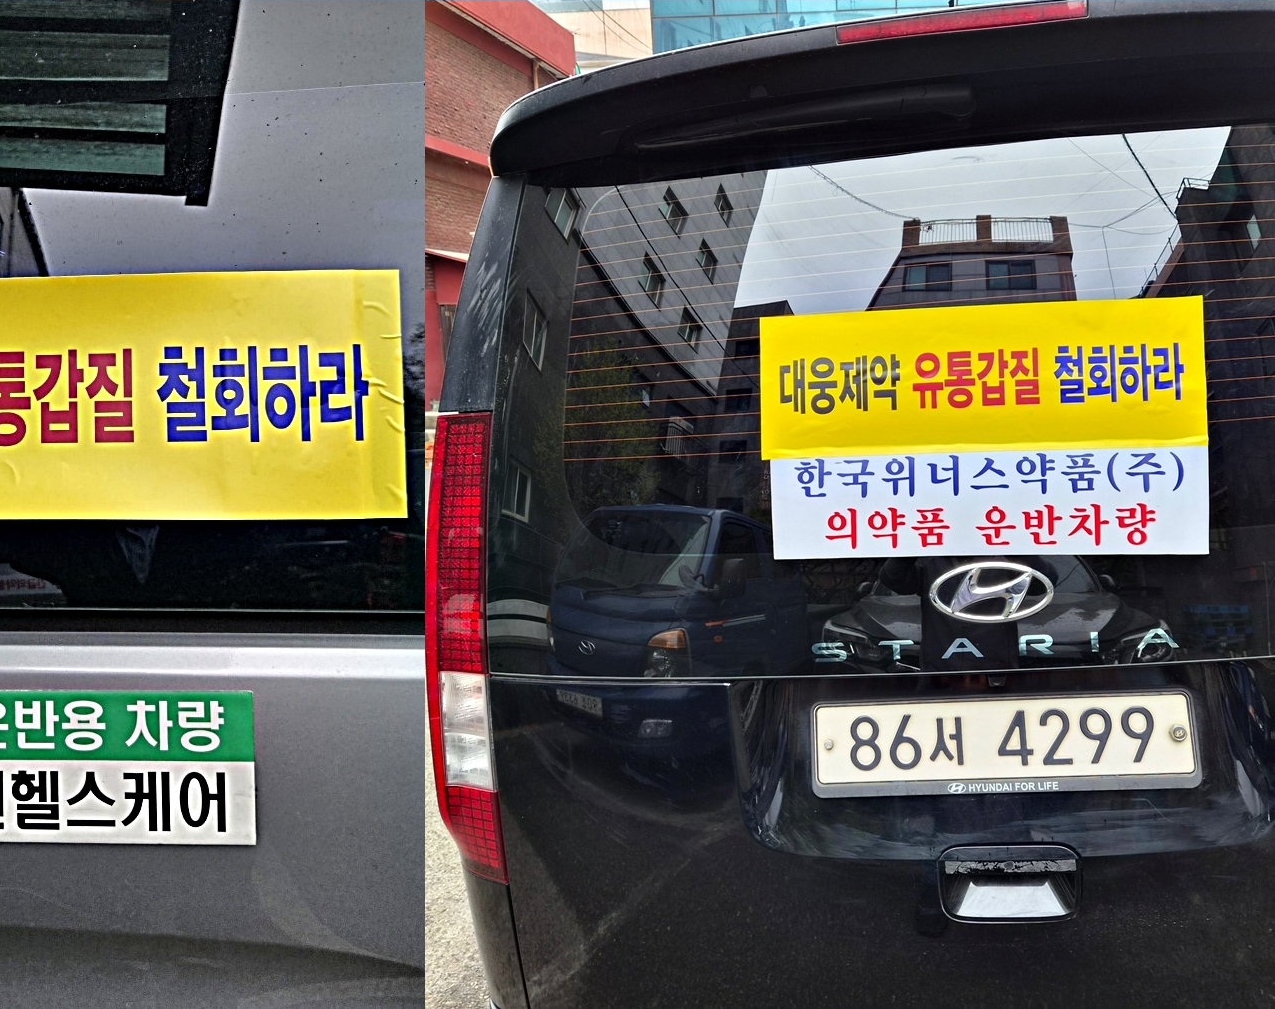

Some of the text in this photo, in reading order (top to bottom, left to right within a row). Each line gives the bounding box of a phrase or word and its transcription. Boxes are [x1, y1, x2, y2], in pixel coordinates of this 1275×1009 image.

[156, 343, 370, 443] 철회하라
[779, 342, 1185, 415] 대웅제약 유통갑질 철회하라
[794, 452, 1184, 499] 한국위너스약품(주)
[824, 502, 1157, 550] 의약품 운반차량
[811, 627, 1180, 664] STARIA
[125, 700, 225, 753] 차량
[850, 705, 1155, 771] 86서 4299
[968, 781, 1060, 793] HYUNDAI FOR LIFE
